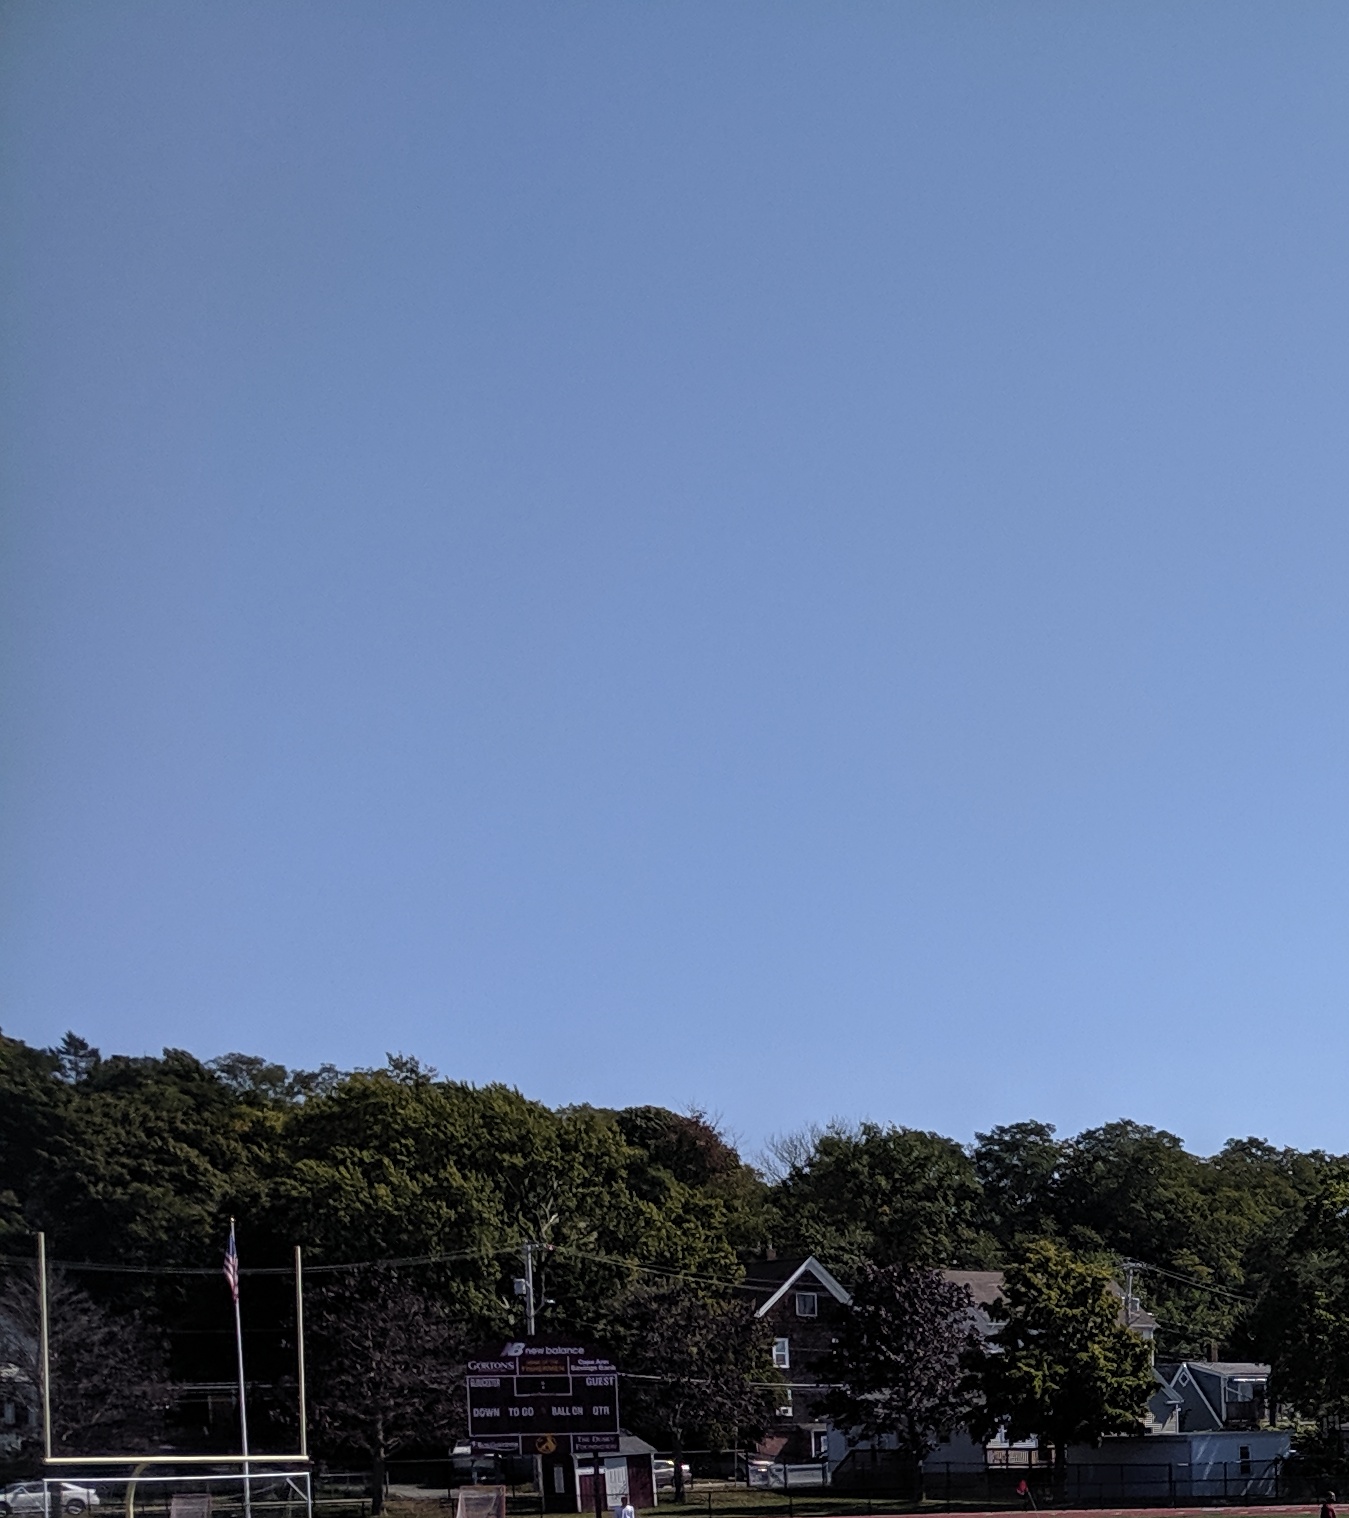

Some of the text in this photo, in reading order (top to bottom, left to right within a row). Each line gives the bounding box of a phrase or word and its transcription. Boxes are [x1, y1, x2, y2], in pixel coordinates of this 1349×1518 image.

[545, 1346, 585, 1355] balance
[585, 1377, 615, 1387] GUEST
[472, 1407, 500, 1418] DOWN
[508, 1407, 520, 1417] TO
[551, 1406, 571, 1416] BALL
